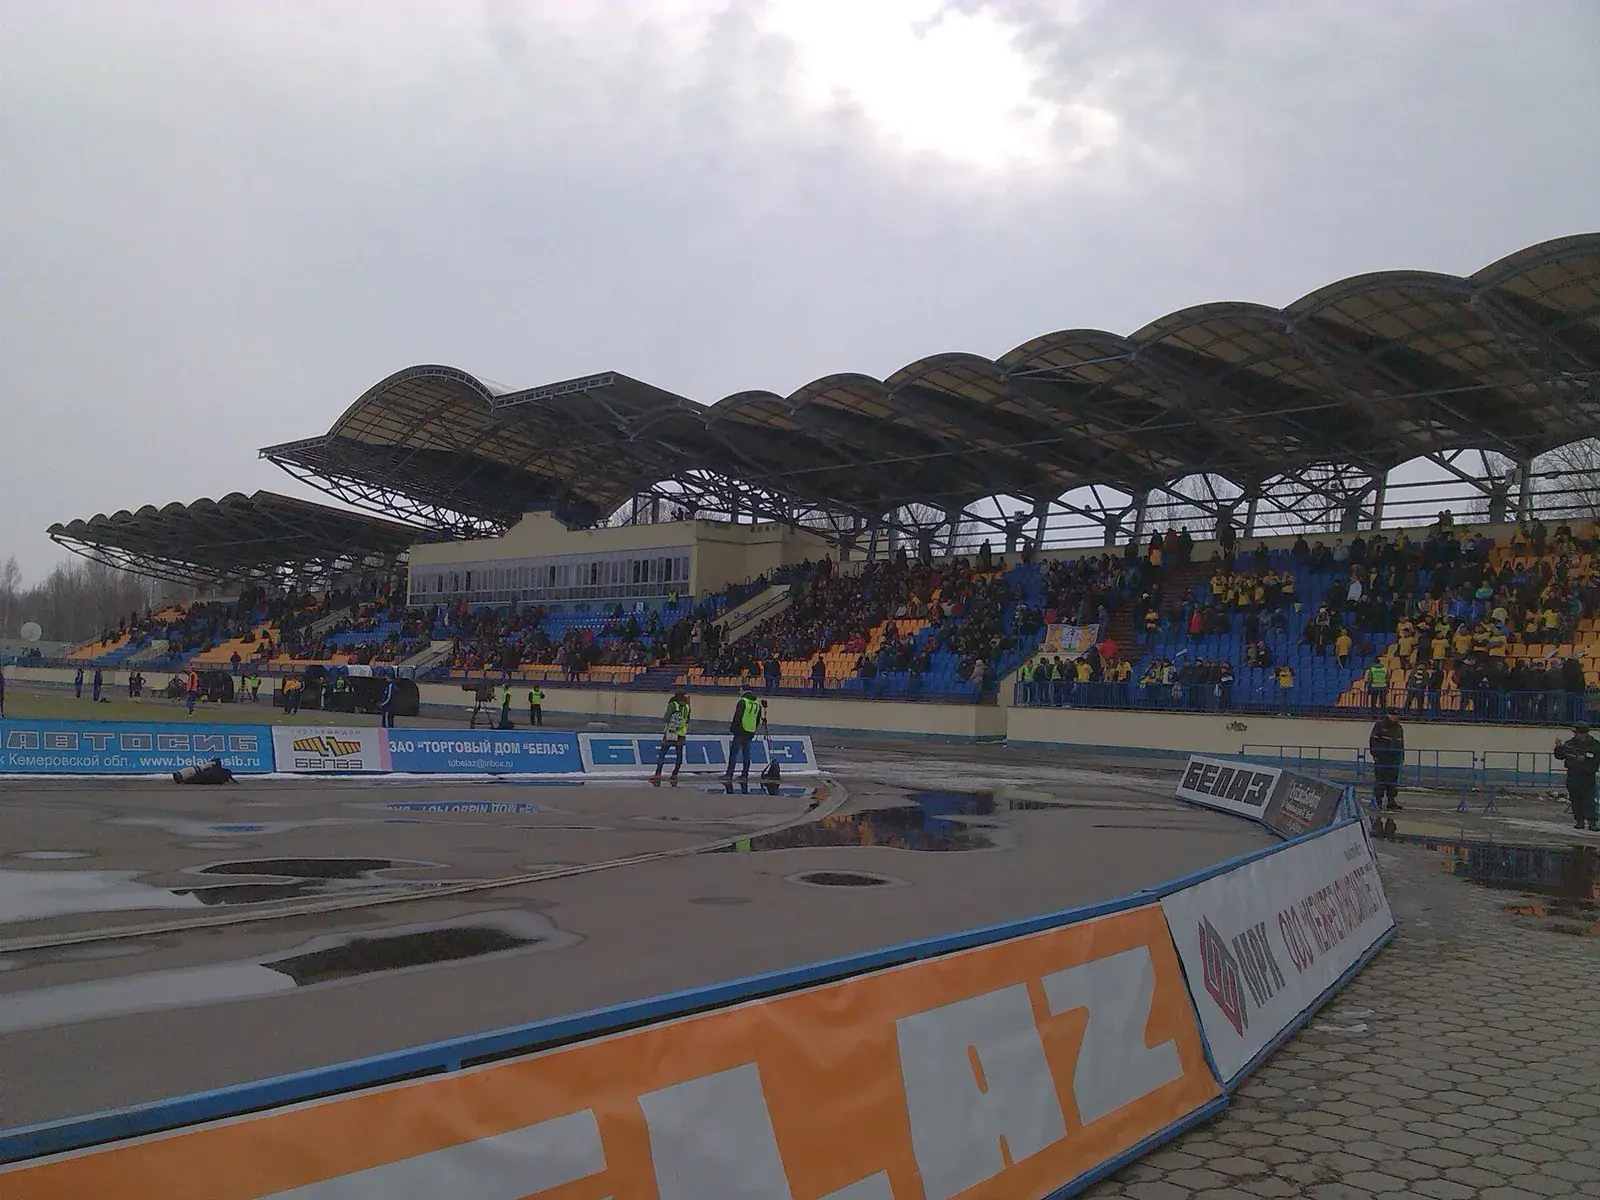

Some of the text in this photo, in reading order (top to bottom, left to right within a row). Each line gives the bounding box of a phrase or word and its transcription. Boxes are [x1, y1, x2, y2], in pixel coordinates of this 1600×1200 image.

[0, 730, 258, 752] АВТОСИБ
[389, 741, 415, 753] ЗАО
[494, 743, 521, 756] ДОМ
[9, 753, 100, 768] Кемеровской
[1182, 761, 1275, 807] БЕЛАЗ
[1231, 921, 1286, 1009] МРК
[1278, 905, 1314, 973] ООО
